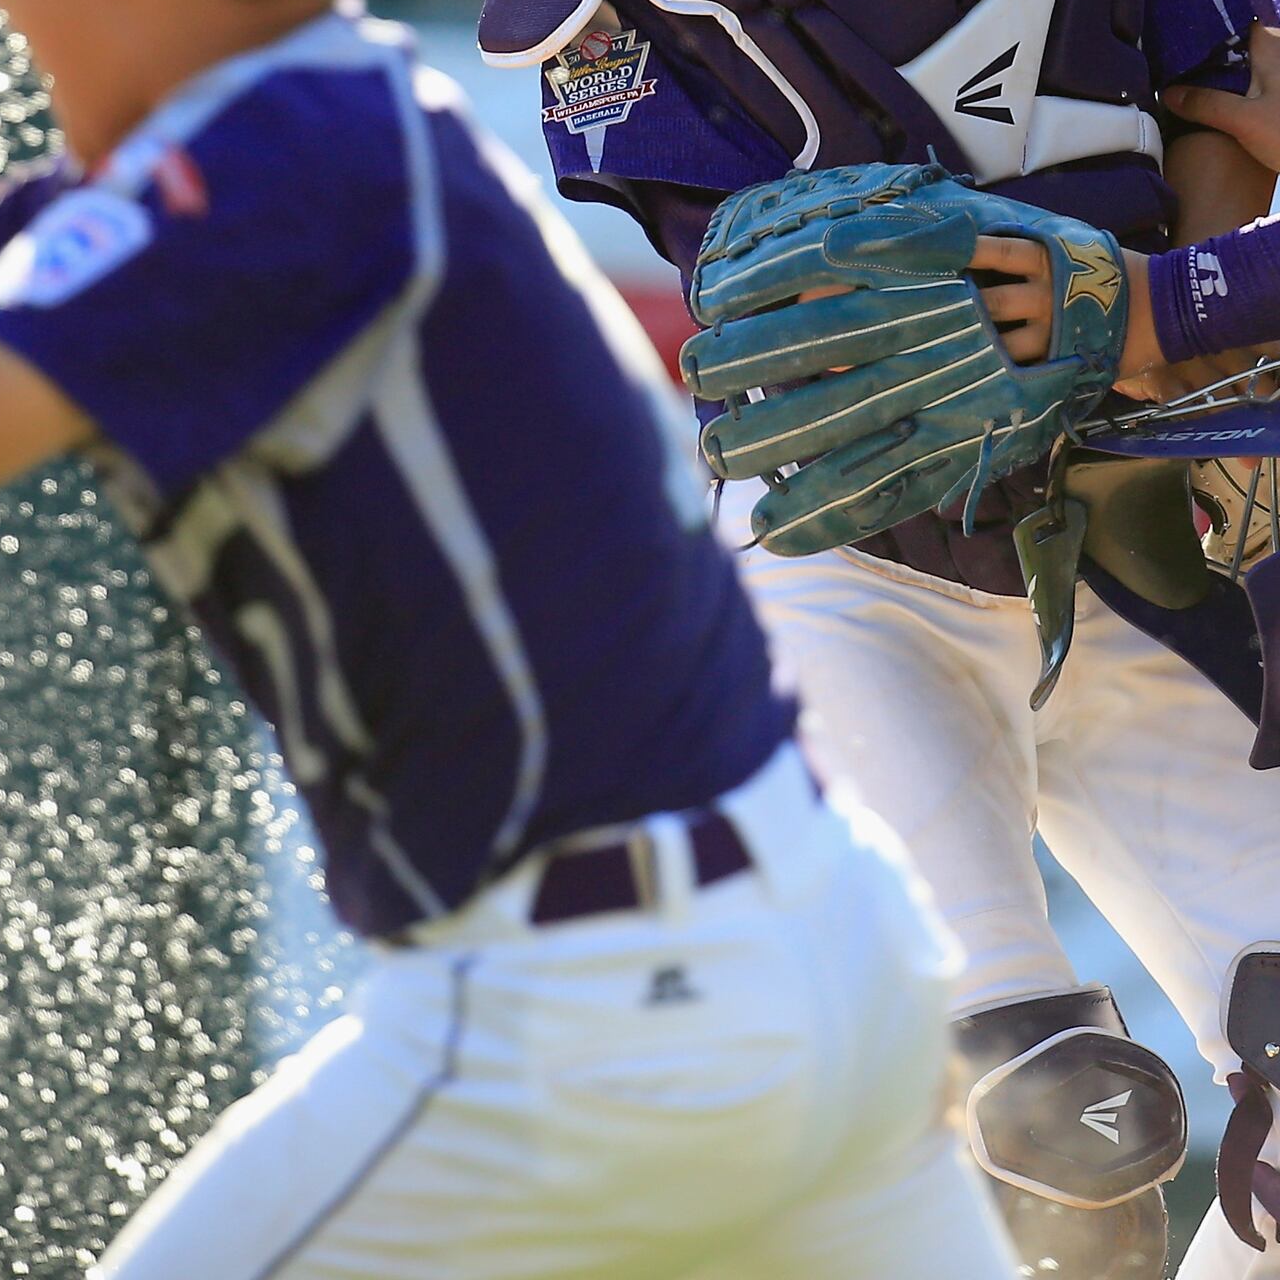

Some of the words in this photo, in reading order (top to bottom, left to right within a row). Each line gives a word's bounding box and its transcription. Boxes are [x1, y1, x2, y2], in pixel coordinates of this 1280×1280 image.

[562, 65, 633, 95] WORLD
[568, 79, 628, 104] SERIES
[626, 90, 639, 99] PA
[573, 106, 622, 125] BASEBALL
[1189, 246, 1208, 322] RUSSELL
